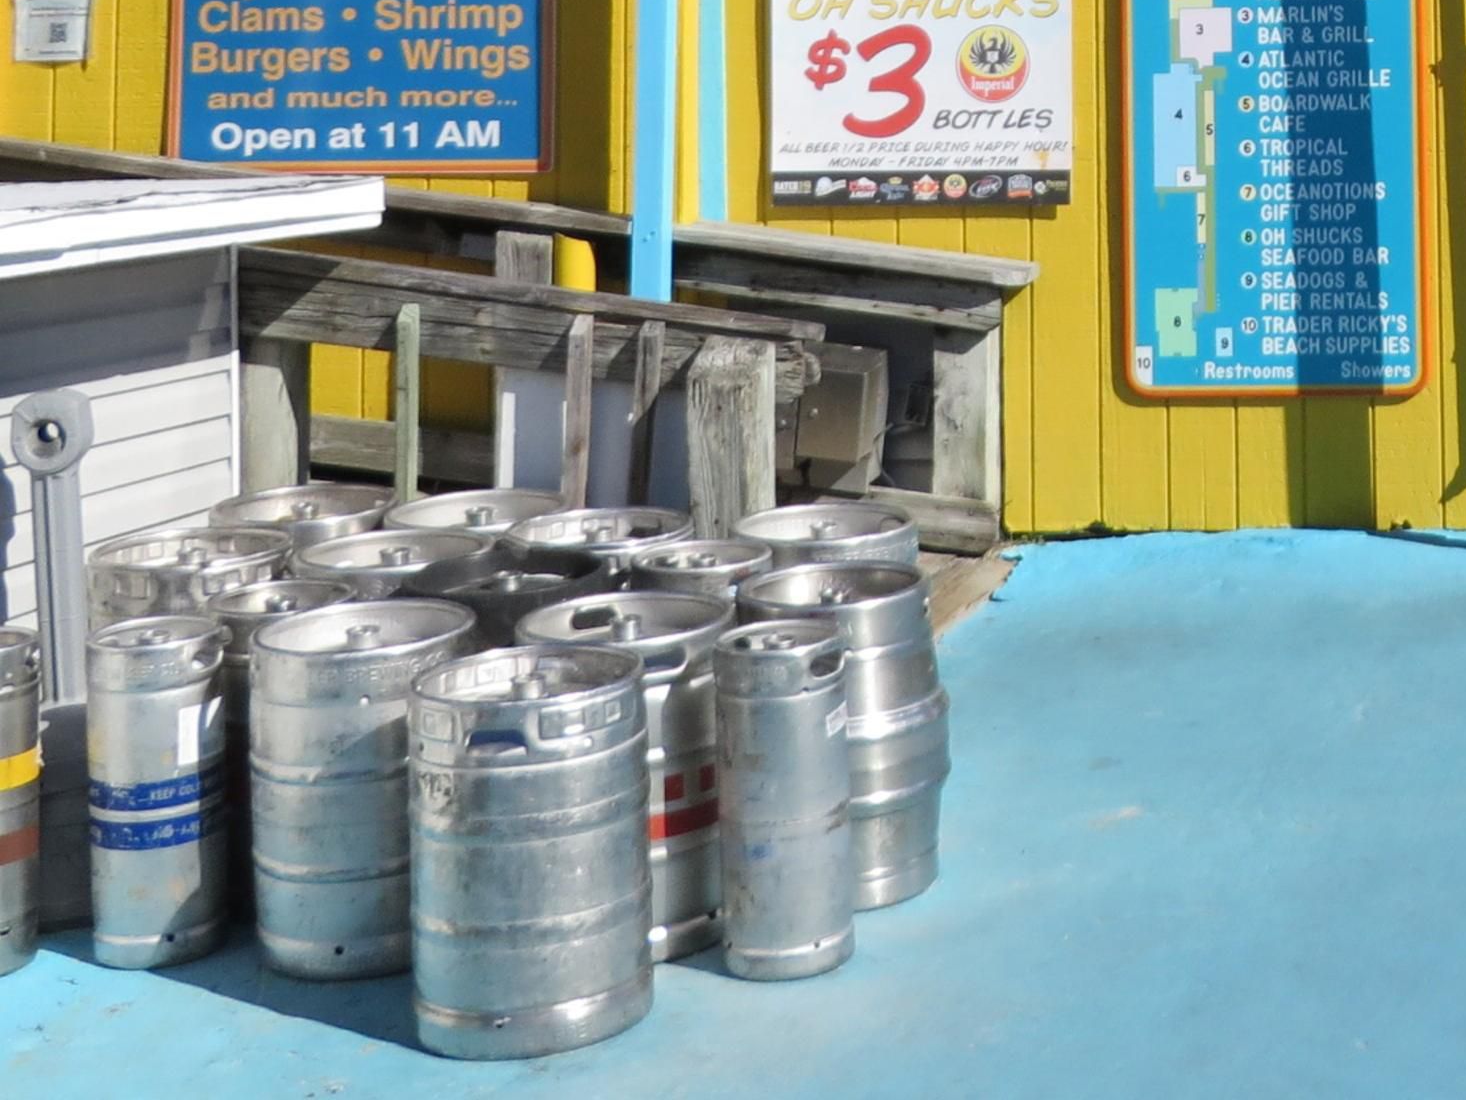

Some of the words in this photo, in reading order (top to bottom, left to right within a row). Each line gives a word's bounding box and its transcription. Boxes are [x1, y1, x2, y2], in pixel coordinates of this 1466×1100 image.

[199, 0, 325, 33] Clams
[1257, 5, 1344, 23] MARLIN'S
[1195, 24, 1204, 36] 3
[1258, 26, 1294, 44] BAR
[1302, 27, 1314, 43] &
[1321, 25, 1375, 43] GRILL
[191, 40, 351, 81] Burgers
[402, 39, 531, 80] Wings
[1258, 50, 1344, 68] ATLANTIC
[804, 23, 932, 138] $3
[971, 74, 1015, 97] Imperial
[1258, 70, 1319, 89] OCEAN
[1327, 69, 1391, 87] GRILLE
[207, 88, 275, 110] and
[287, 86, 388, 109] much
[1259, 94, 1371, 113] BOARDWALK
[932, 108, 1053, 131] BOTTLES
[1174, 109, 1183, 121] 4
[1259, 115, 1306, 133] CAFE
[211, 122, 316, 157] Open
[329, 123, 366, 149] at
[379, 122, 418, 149] 11
[436, 121, 501, 148] AM
[1206, 124, 1214, 136] 5
[779, 143, 801, 154] ALL
[805, 142, 840, 153] BEER
[842, 142, 865, 153] 1/2
[867, 141, 911, 153] PRICE
[914, 141, 967, 153] DURING
[974, 140, 1020, 152] HAPPY
[1024, 140, 1068, 152] HOUR!
[1260, 138, 1348, 156] TROPICAL
[828, 156, 884, 168] MONDAY
[898, 156, 949, 167] FRIDAY
[953, 156, 1020, 167] 4PM-7PM
[1260, 159, 1344, 177] THREADS
[1183, 170, 1191, 182] 6
[1260, 182, 1386, 200] OCEANOTIONS
[1197, 214, 1206, 226] 7
[1260, 204, 1301, 221] GIFT
[1309, 203, 1356, 221] SHOP
[1260, 228, 1286, 245] OH
[1292, 226, 1363, 244] SHUCKS
[1261, 248, 1345, 267] SEAFOOD
[1352, 247, 1389, 265] BAR
[1261, 271, 1345, 289] SEADOGS
[1355, 271, 1368, 289] &
[1261, 293, 1302, 311] PIER
[1309, 292, 1388, 310] RENTALS
[1242, 319, 1257, 331] 10
[1263, 315, 1333, 333] TRADER
[1339, 314, 1407, 333] RICKY'S
[1262, 337, 1320, 355] BEACH
[1325, 336, 1410, 354] SUPPLIES
[1137, 358, 1151, 370] 10
[1204, 362, 1295, 379] Restrooms
[1340, 361, 1411, 379] Showers
